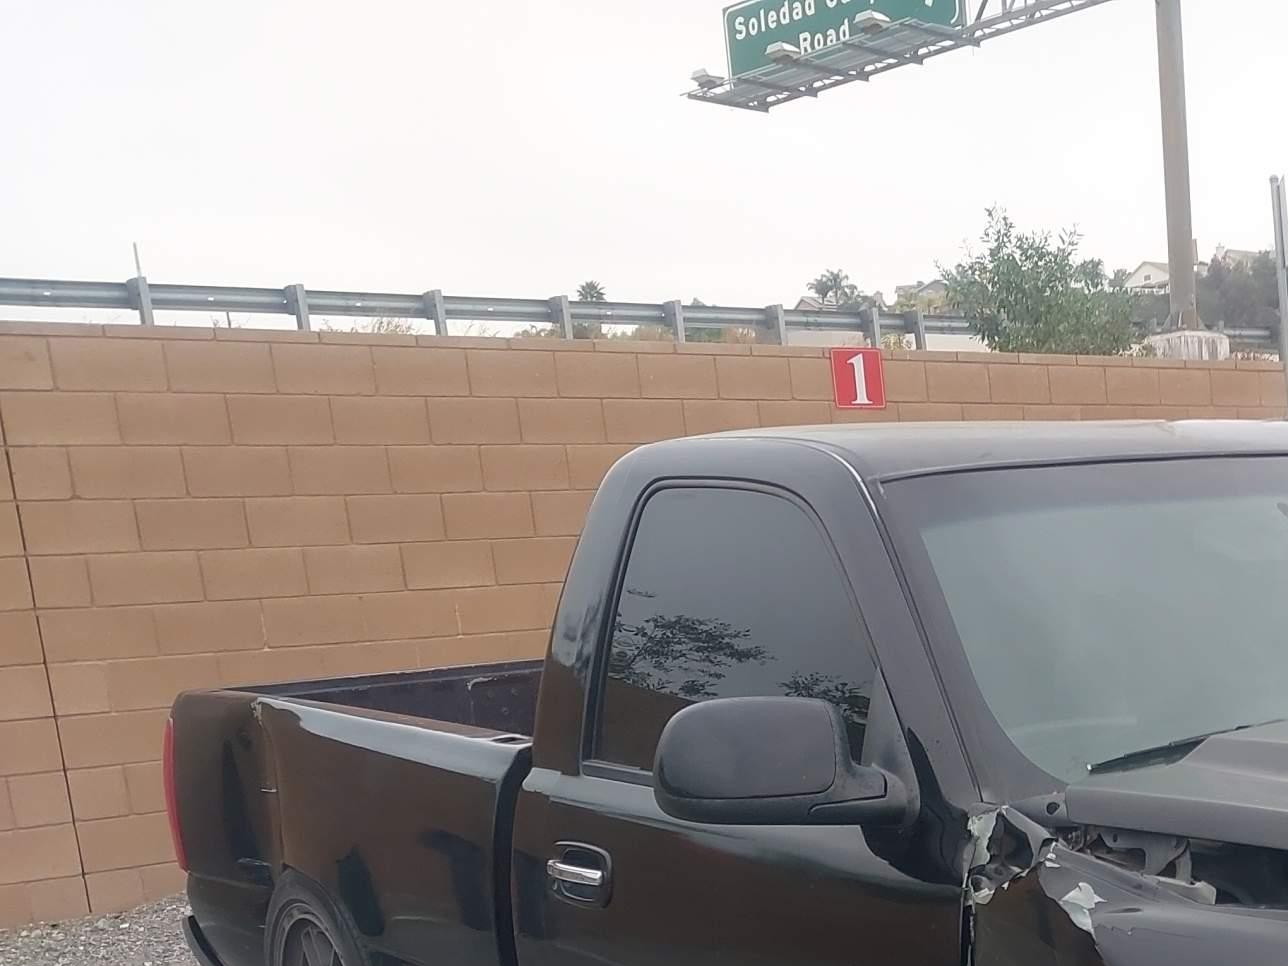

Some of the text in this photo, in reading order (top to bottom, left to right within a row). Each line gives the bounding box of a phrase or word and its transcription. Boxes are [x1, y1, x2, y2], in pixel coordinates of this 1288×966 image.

[735, 0, 815, 40] Soledad
[799, 18, 850, 55] Road
[846, 352, 873, 404] 1
